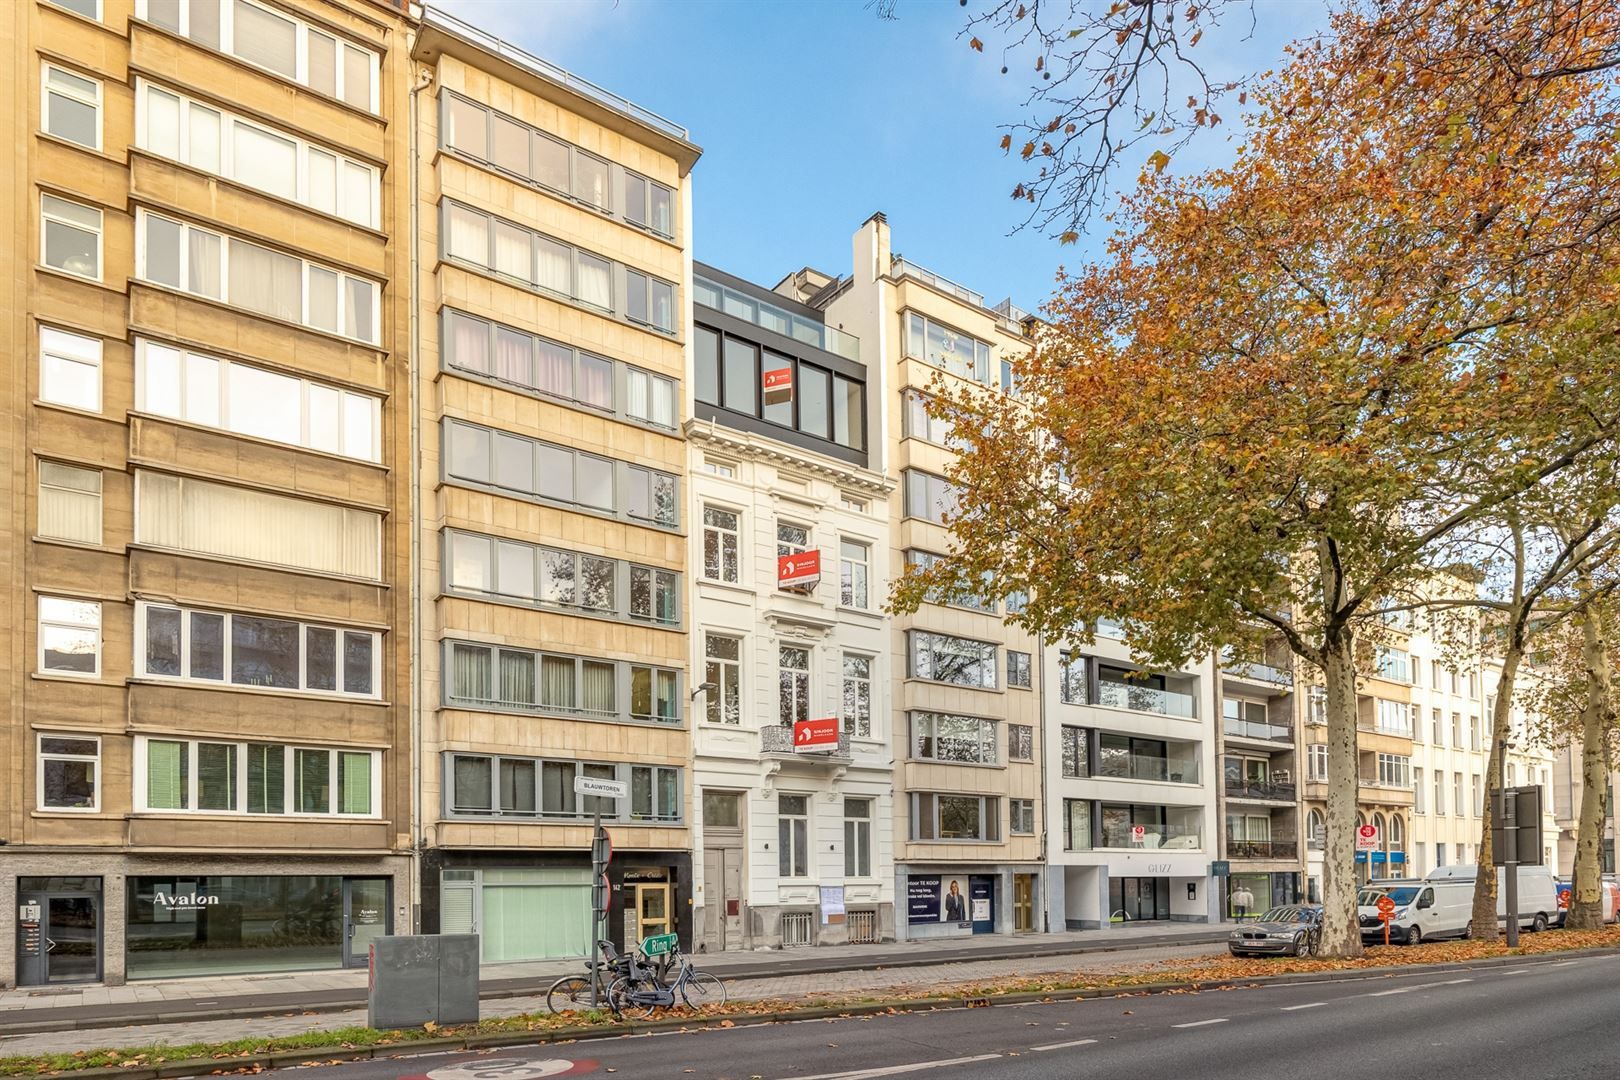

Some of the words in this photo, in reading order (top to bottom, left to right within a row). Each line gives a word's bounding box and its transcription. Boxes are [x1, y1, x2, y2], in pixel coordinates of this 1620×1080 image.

[584, 782, 620, 792] BLAUWTOREN
[153, 891, 219, 905] Avalon
[652, 939, 667, 952] Ring
